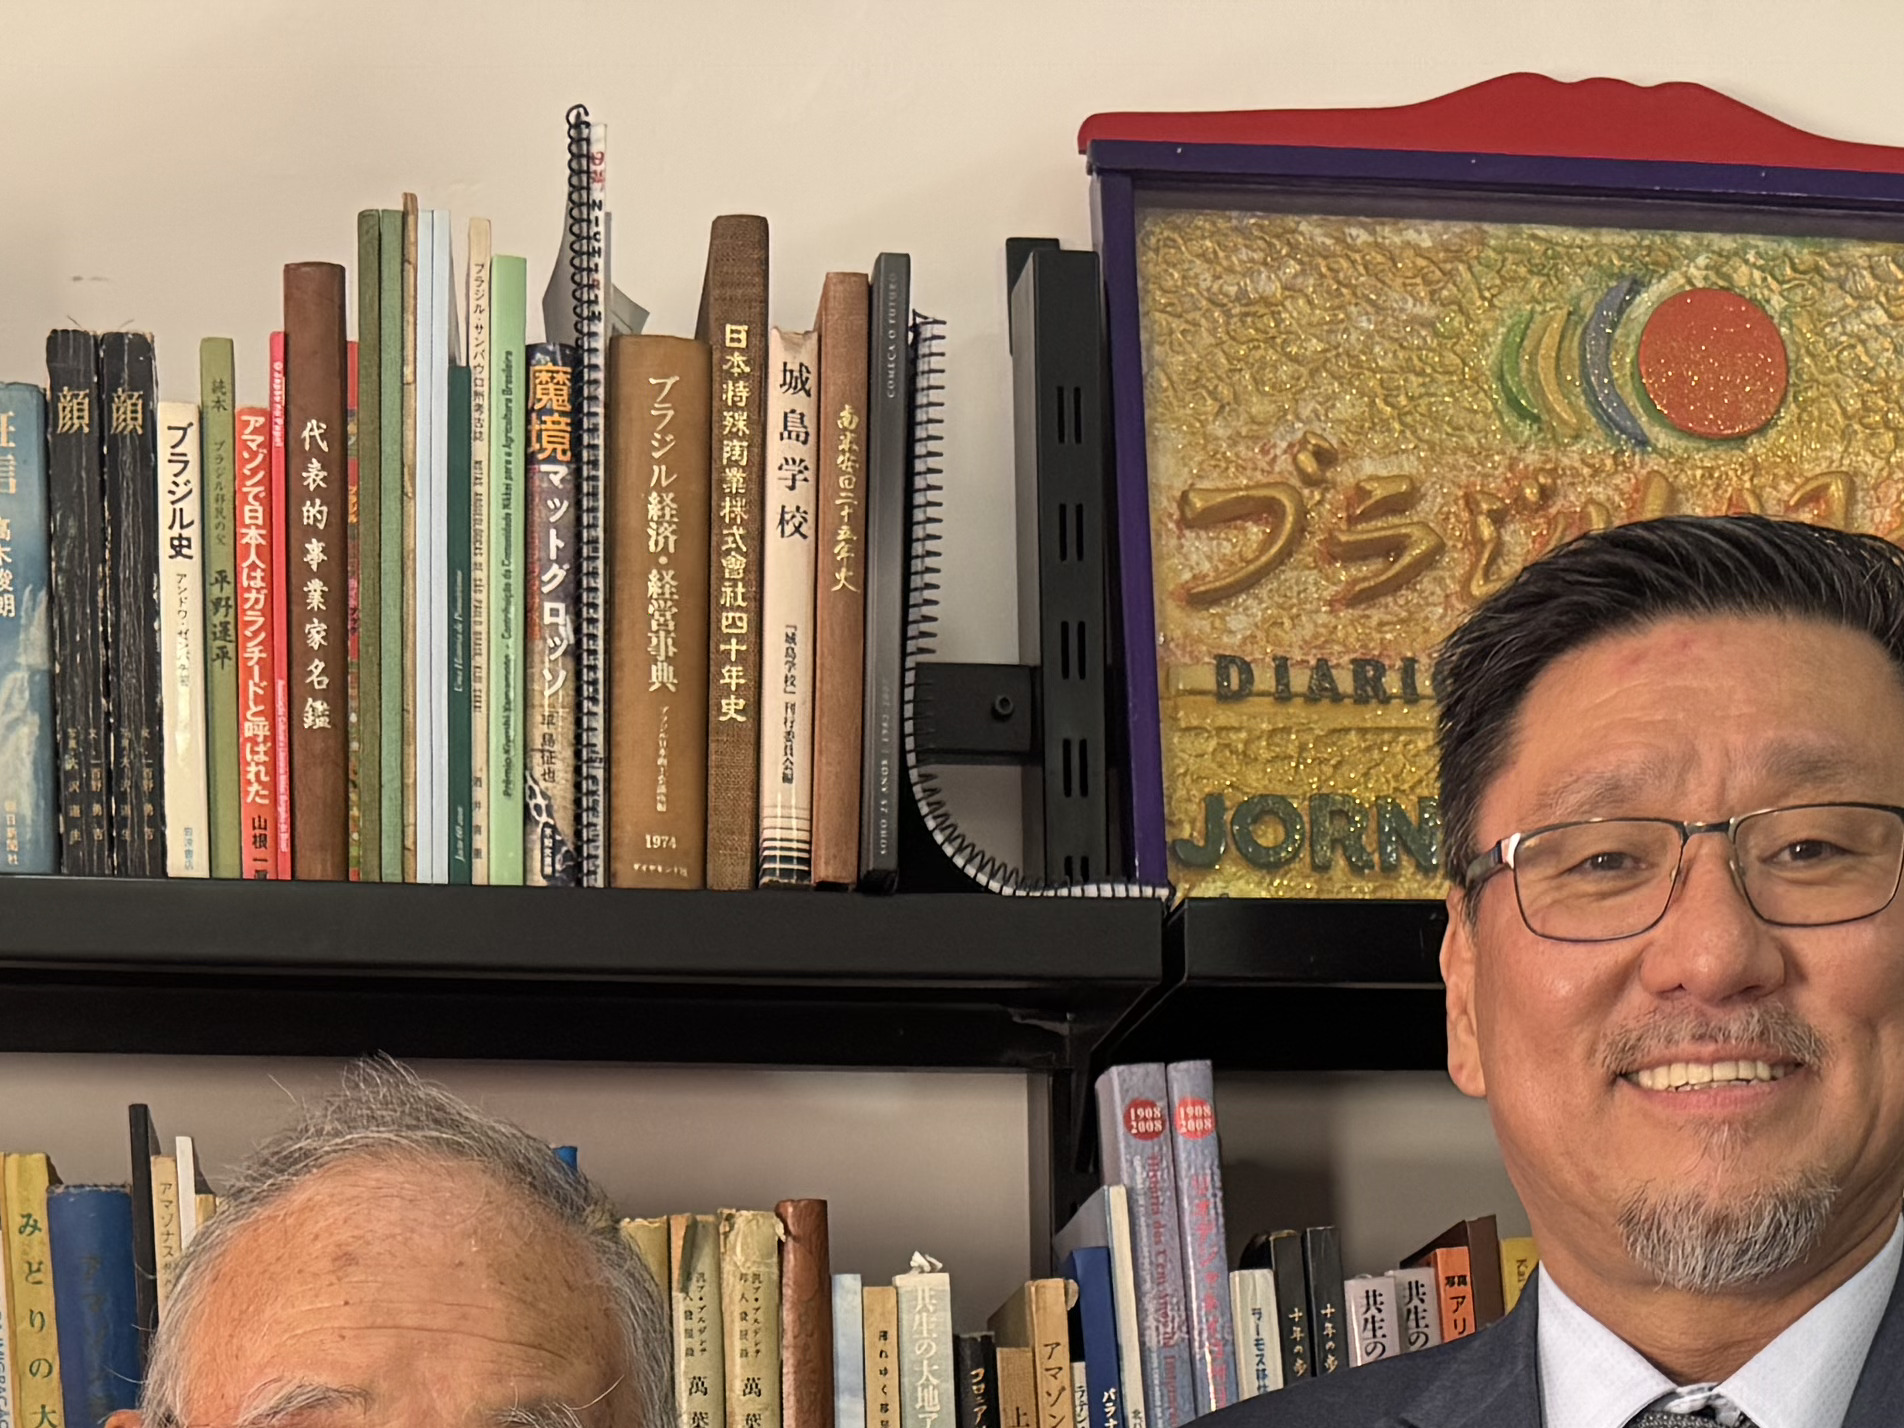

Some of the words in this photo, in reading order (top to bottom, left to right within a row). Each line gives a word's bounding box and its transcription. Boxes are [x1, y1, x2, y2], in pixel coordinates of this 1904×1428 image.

[55, 388, 90, 434] 顔
[110, 389, 145, 435] 顔
[166, 422, 194, 560] ブラジル史
[645, 834, 677, 849] 1974
[1129, 1106, 1162, 1120] 1908
[1179, 1104, 1212, 1119] 1908
[1130, 1120, 1164, 1135] 2008
[1180, 1119, 1213, 1133] 2008
